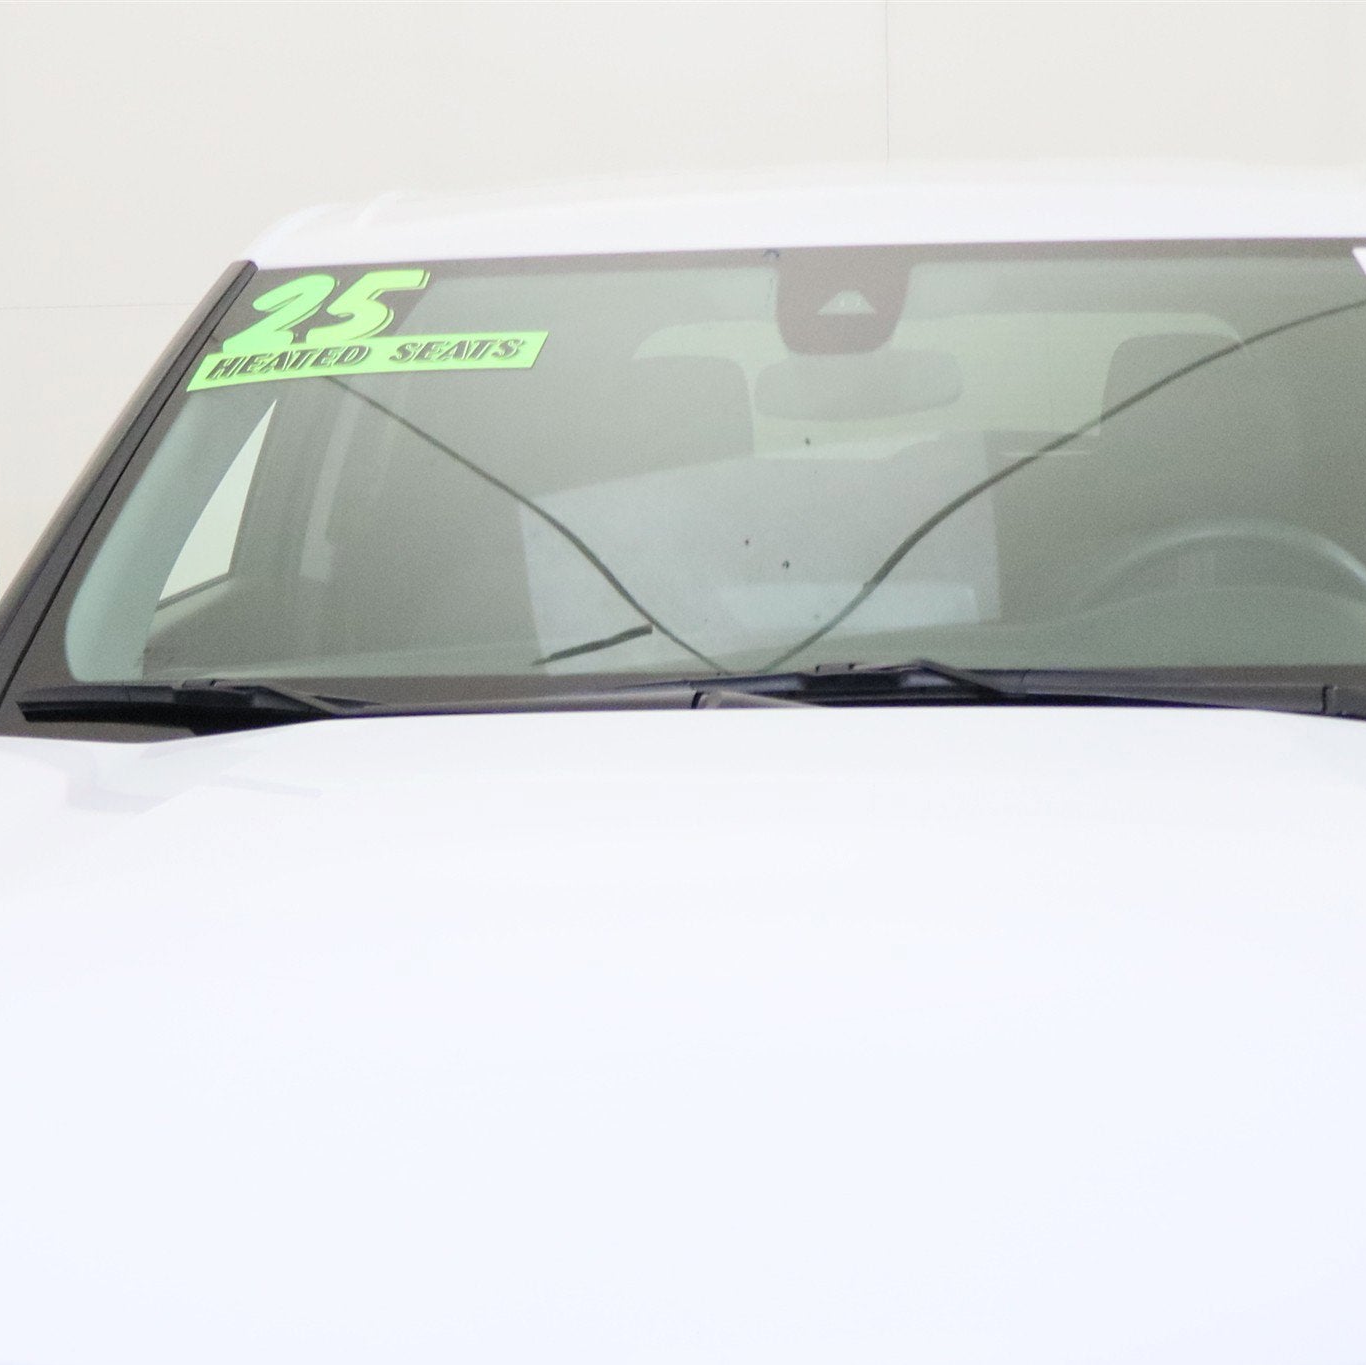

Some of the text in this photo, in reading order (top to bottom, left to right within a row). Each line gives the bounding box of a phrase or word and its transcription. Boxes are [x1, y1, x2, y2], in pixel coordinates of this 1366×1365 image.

[223, 269, 431, 354] 25
[205, 338, 526, 380] HEATED SEATS
